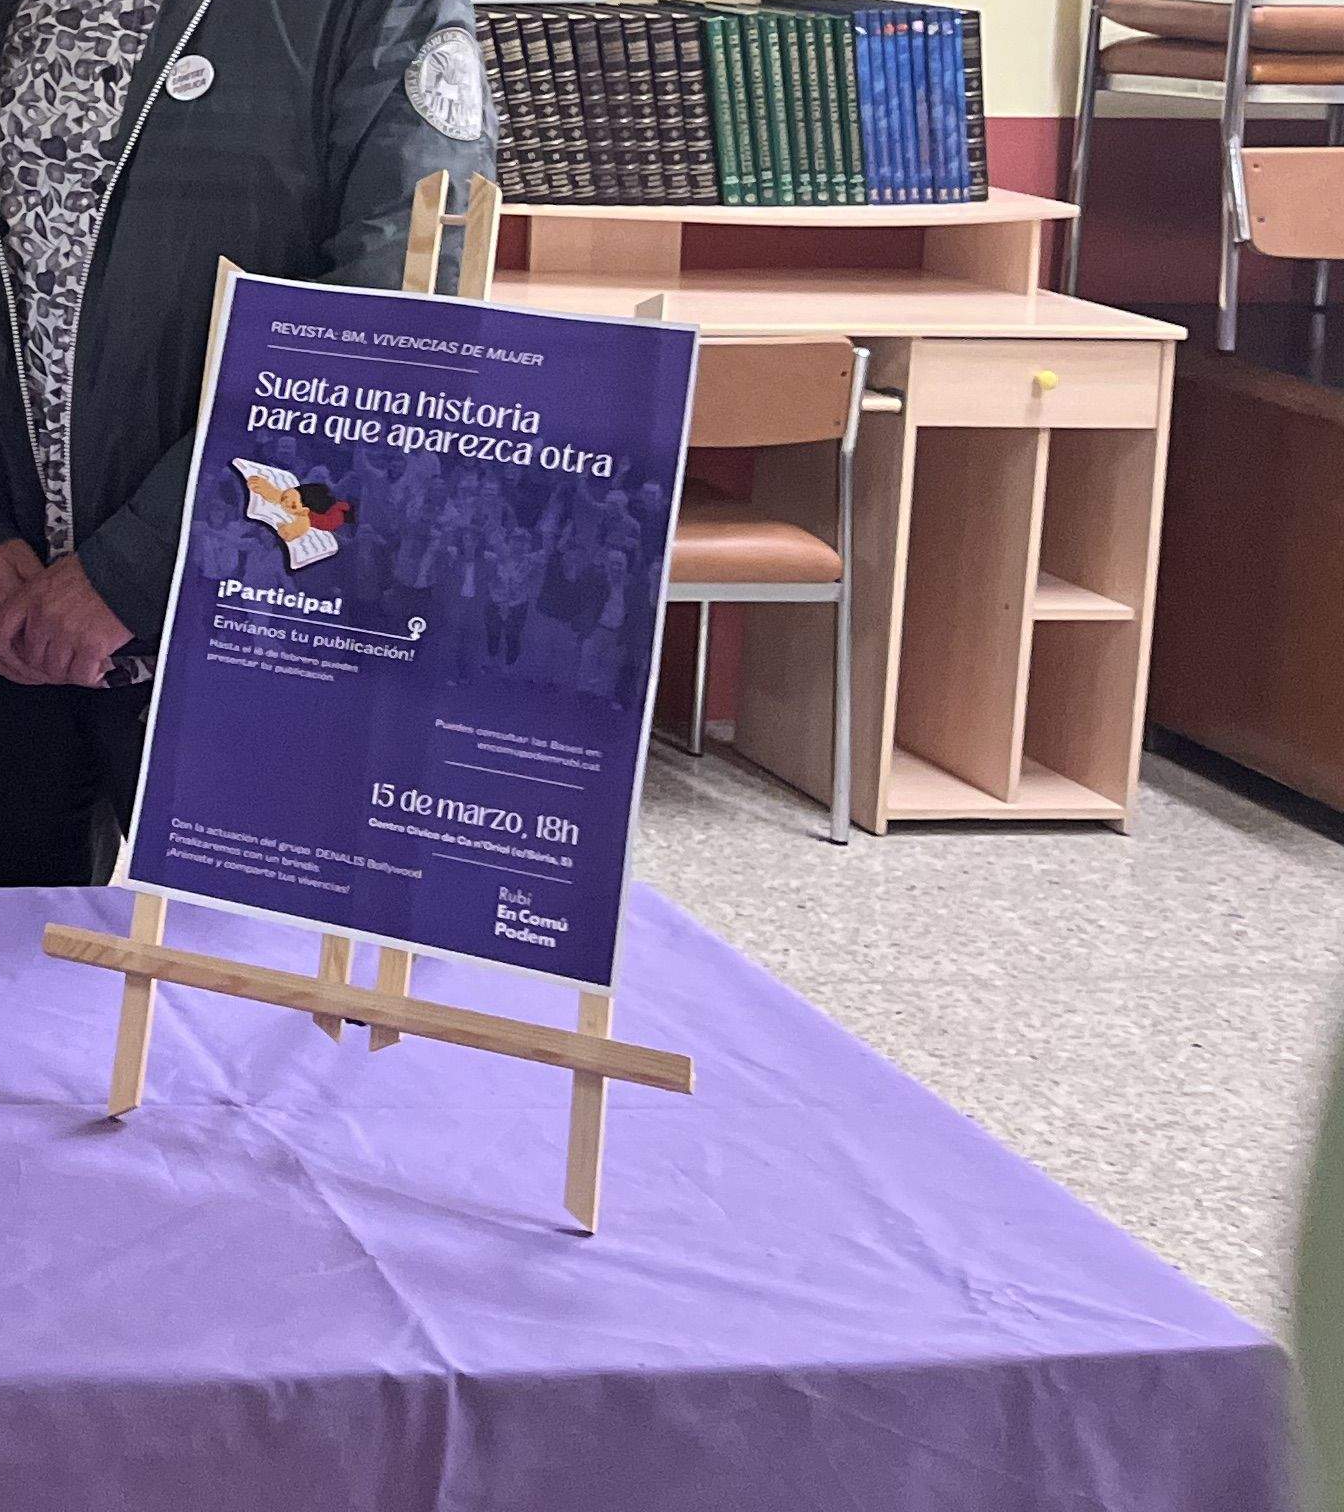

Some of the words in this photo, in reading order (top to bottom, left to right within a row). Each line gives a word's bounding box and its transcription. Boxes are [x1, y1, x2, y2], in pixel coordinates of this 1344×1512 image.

[271, 321, 339, 340] REVISTA:
[373, 333, 458, 355] VIVENCIAS
[461, 344, 484, 358] DE
[485, 347, 544, 367] MUJER
[255, 370, 349, 408] Suelta
[355, 387, 410, 416] una
[415, 390, 541, 435] historia
[247, 405, 317, 435] para
[323, 414, 382, 445] que
[387, 423, 533, 466] aparezca
[540, 444, 613, 478] otra
[217, 579, 343, 615] ¡Participa!
[291, 628, 309, 644] tu
[313, 634, 416, 662] publicación!
[368, 817, 406, 833] Centro
[441, 833, 457, 844] de
[457, 835, 472, 847] Ca
[371, 782, 395, 808] 15
[400, 789, 433, 816] de
[437, 797, 527, 839] marzo,
[535, 814, 580, 846] 18h
[172, 818, 193, 831] Con
[194, 822, 205, 833] la
[260, 838, 277, 848] del
[278, 842, 311, 855] grupo
[243, 850, 262, 860] con
[264, 854, 280, 864] un
[495, 921, 556, 948] Podem
[497, 904, 517, 922] En
[518, 909, 569, 932] Comú
